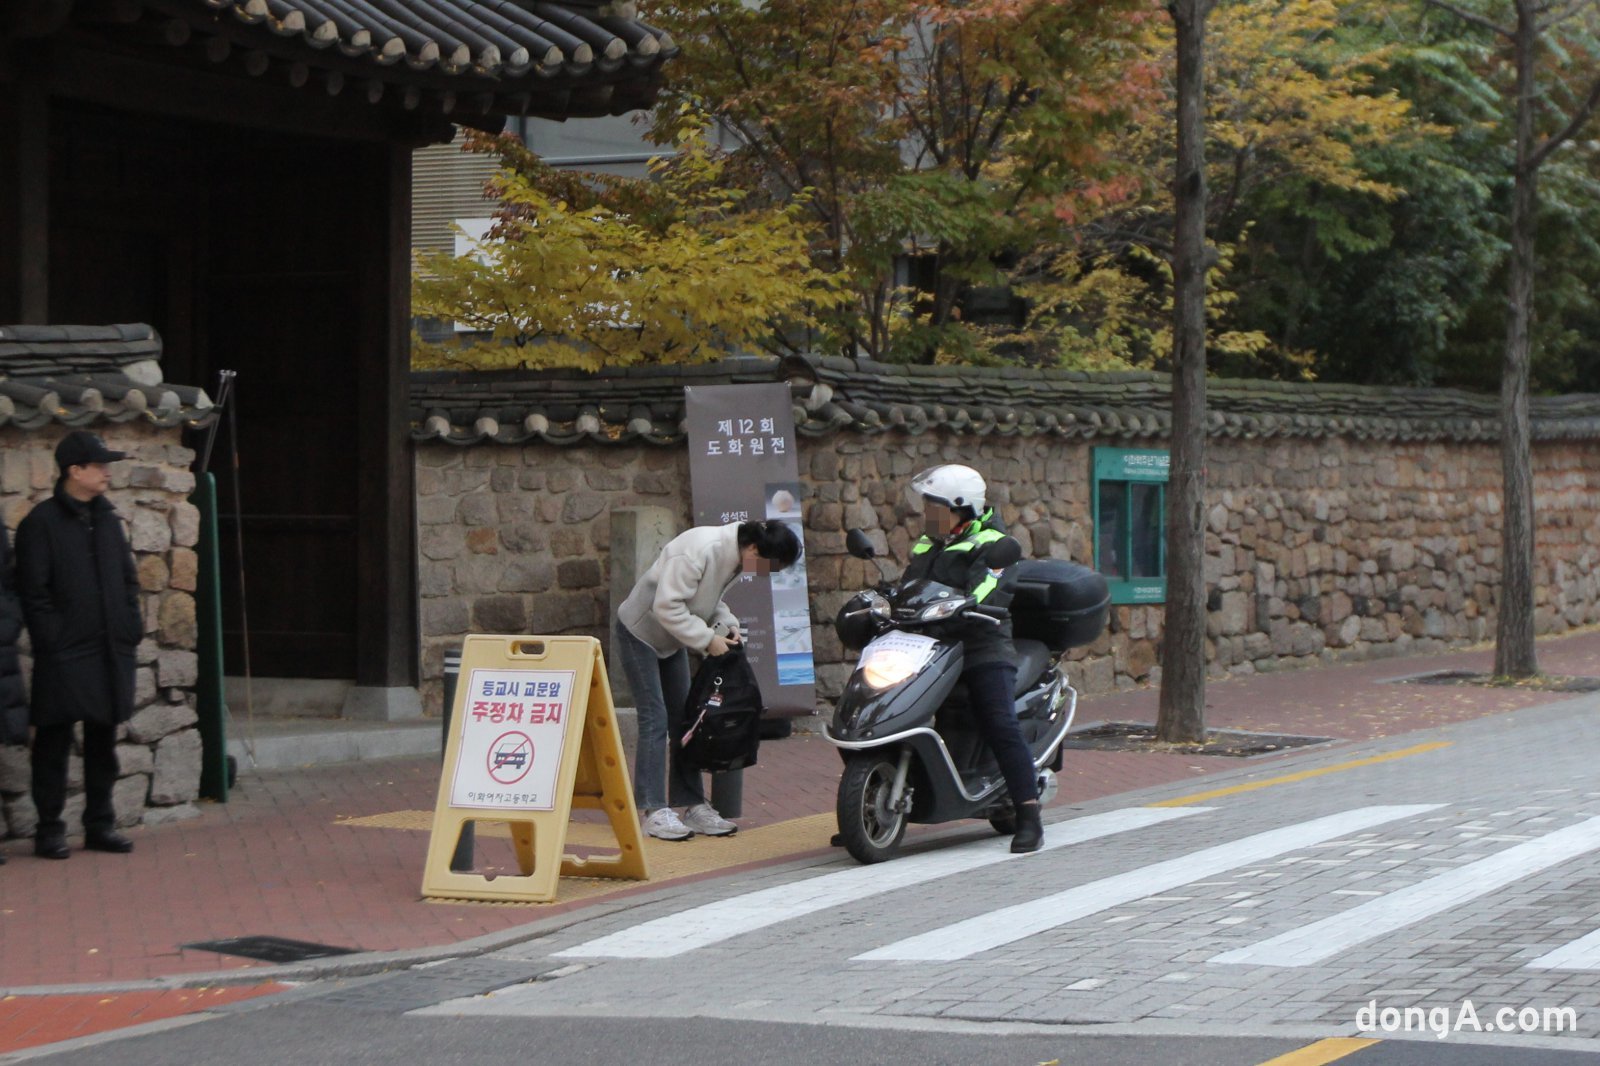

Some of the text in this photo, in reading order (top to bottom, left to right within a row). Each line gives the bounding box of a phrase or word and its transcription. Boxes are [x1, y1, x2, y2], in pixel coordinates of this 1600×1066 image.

[720, 511, 749, 523] 성석진
[482, 680, 561, 698] 등교시 교문앞
[472, 701, 563, 725] 주정차 금지
[468, 791, 538, 805] 이화여자고등학교
